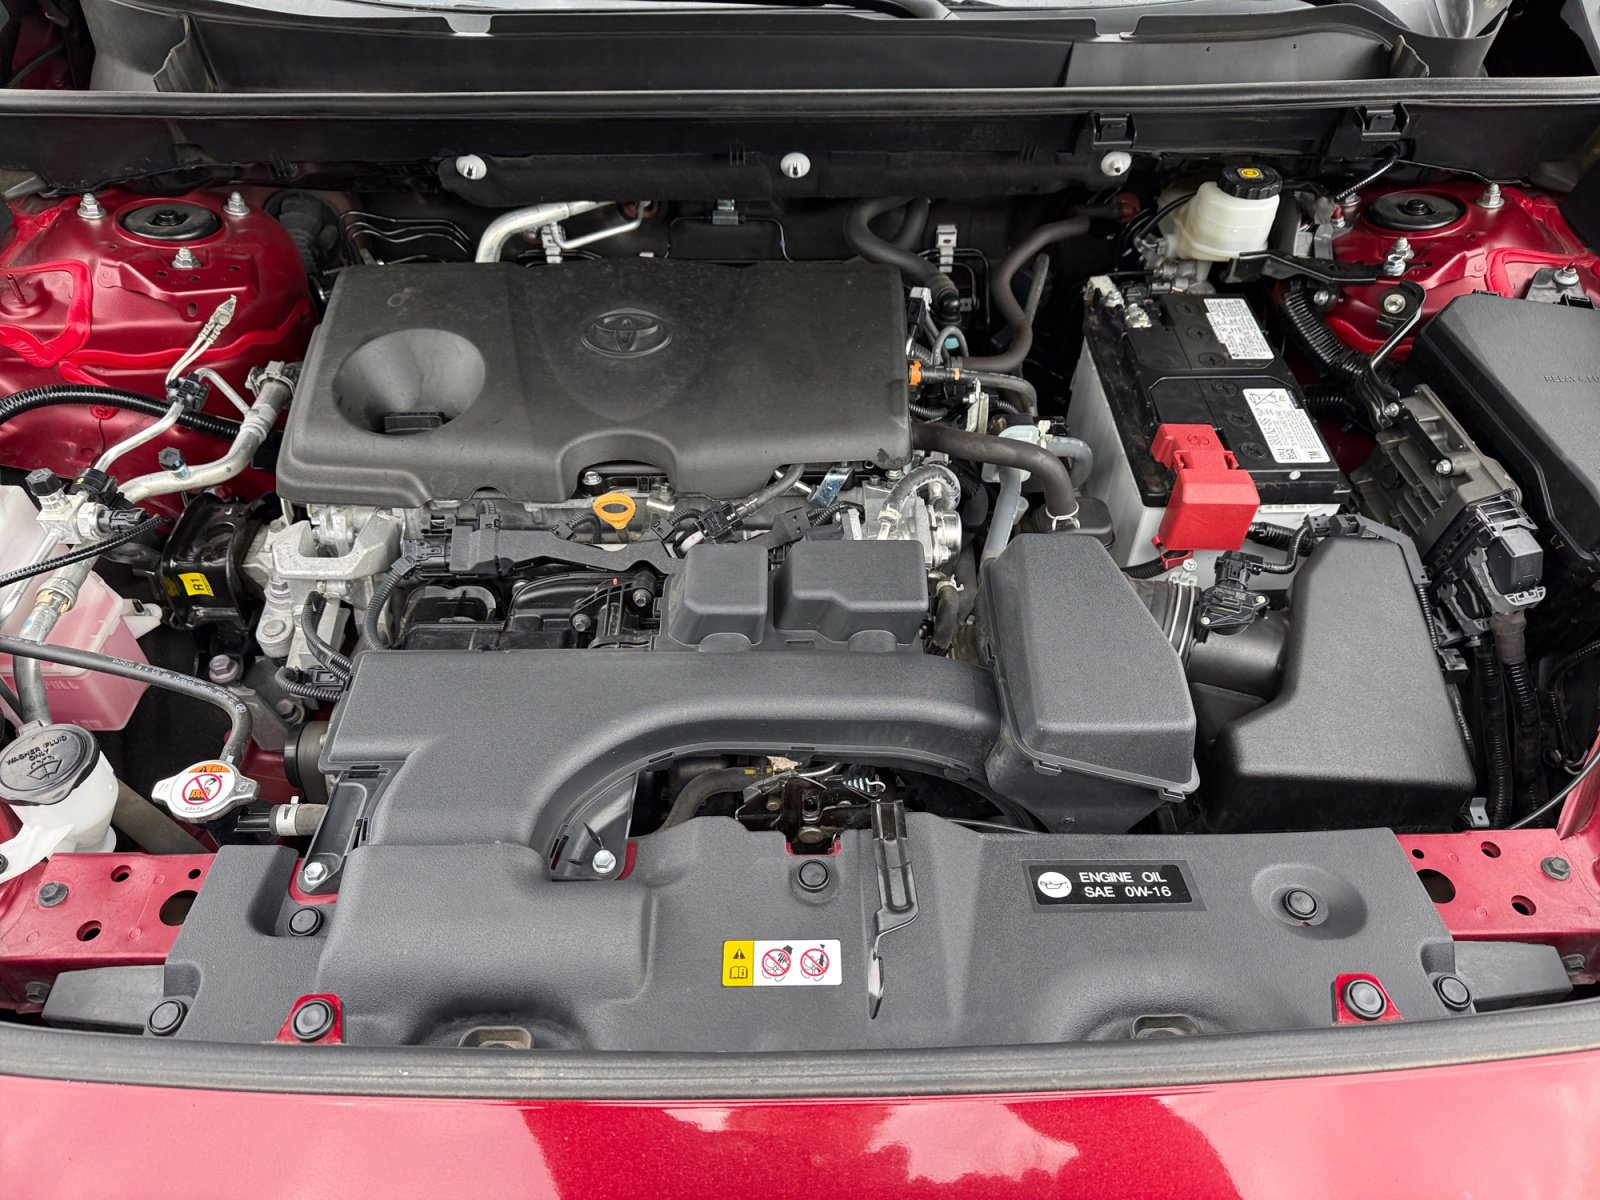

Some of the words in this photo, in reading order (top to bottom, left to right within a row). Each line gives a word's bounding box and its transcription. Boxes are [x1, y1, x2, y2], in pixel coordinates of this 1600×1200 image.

[5, 746, 41, 766] WASHER
[28, 748, 49, 761] ONLY
[1079, 872, 1133, 883] ENGINE
[1142, 872, 1167, 883] OIL
[1084, 886, 1116, 898] SAE
[1125, 886, 1172, 897] 0W-16
